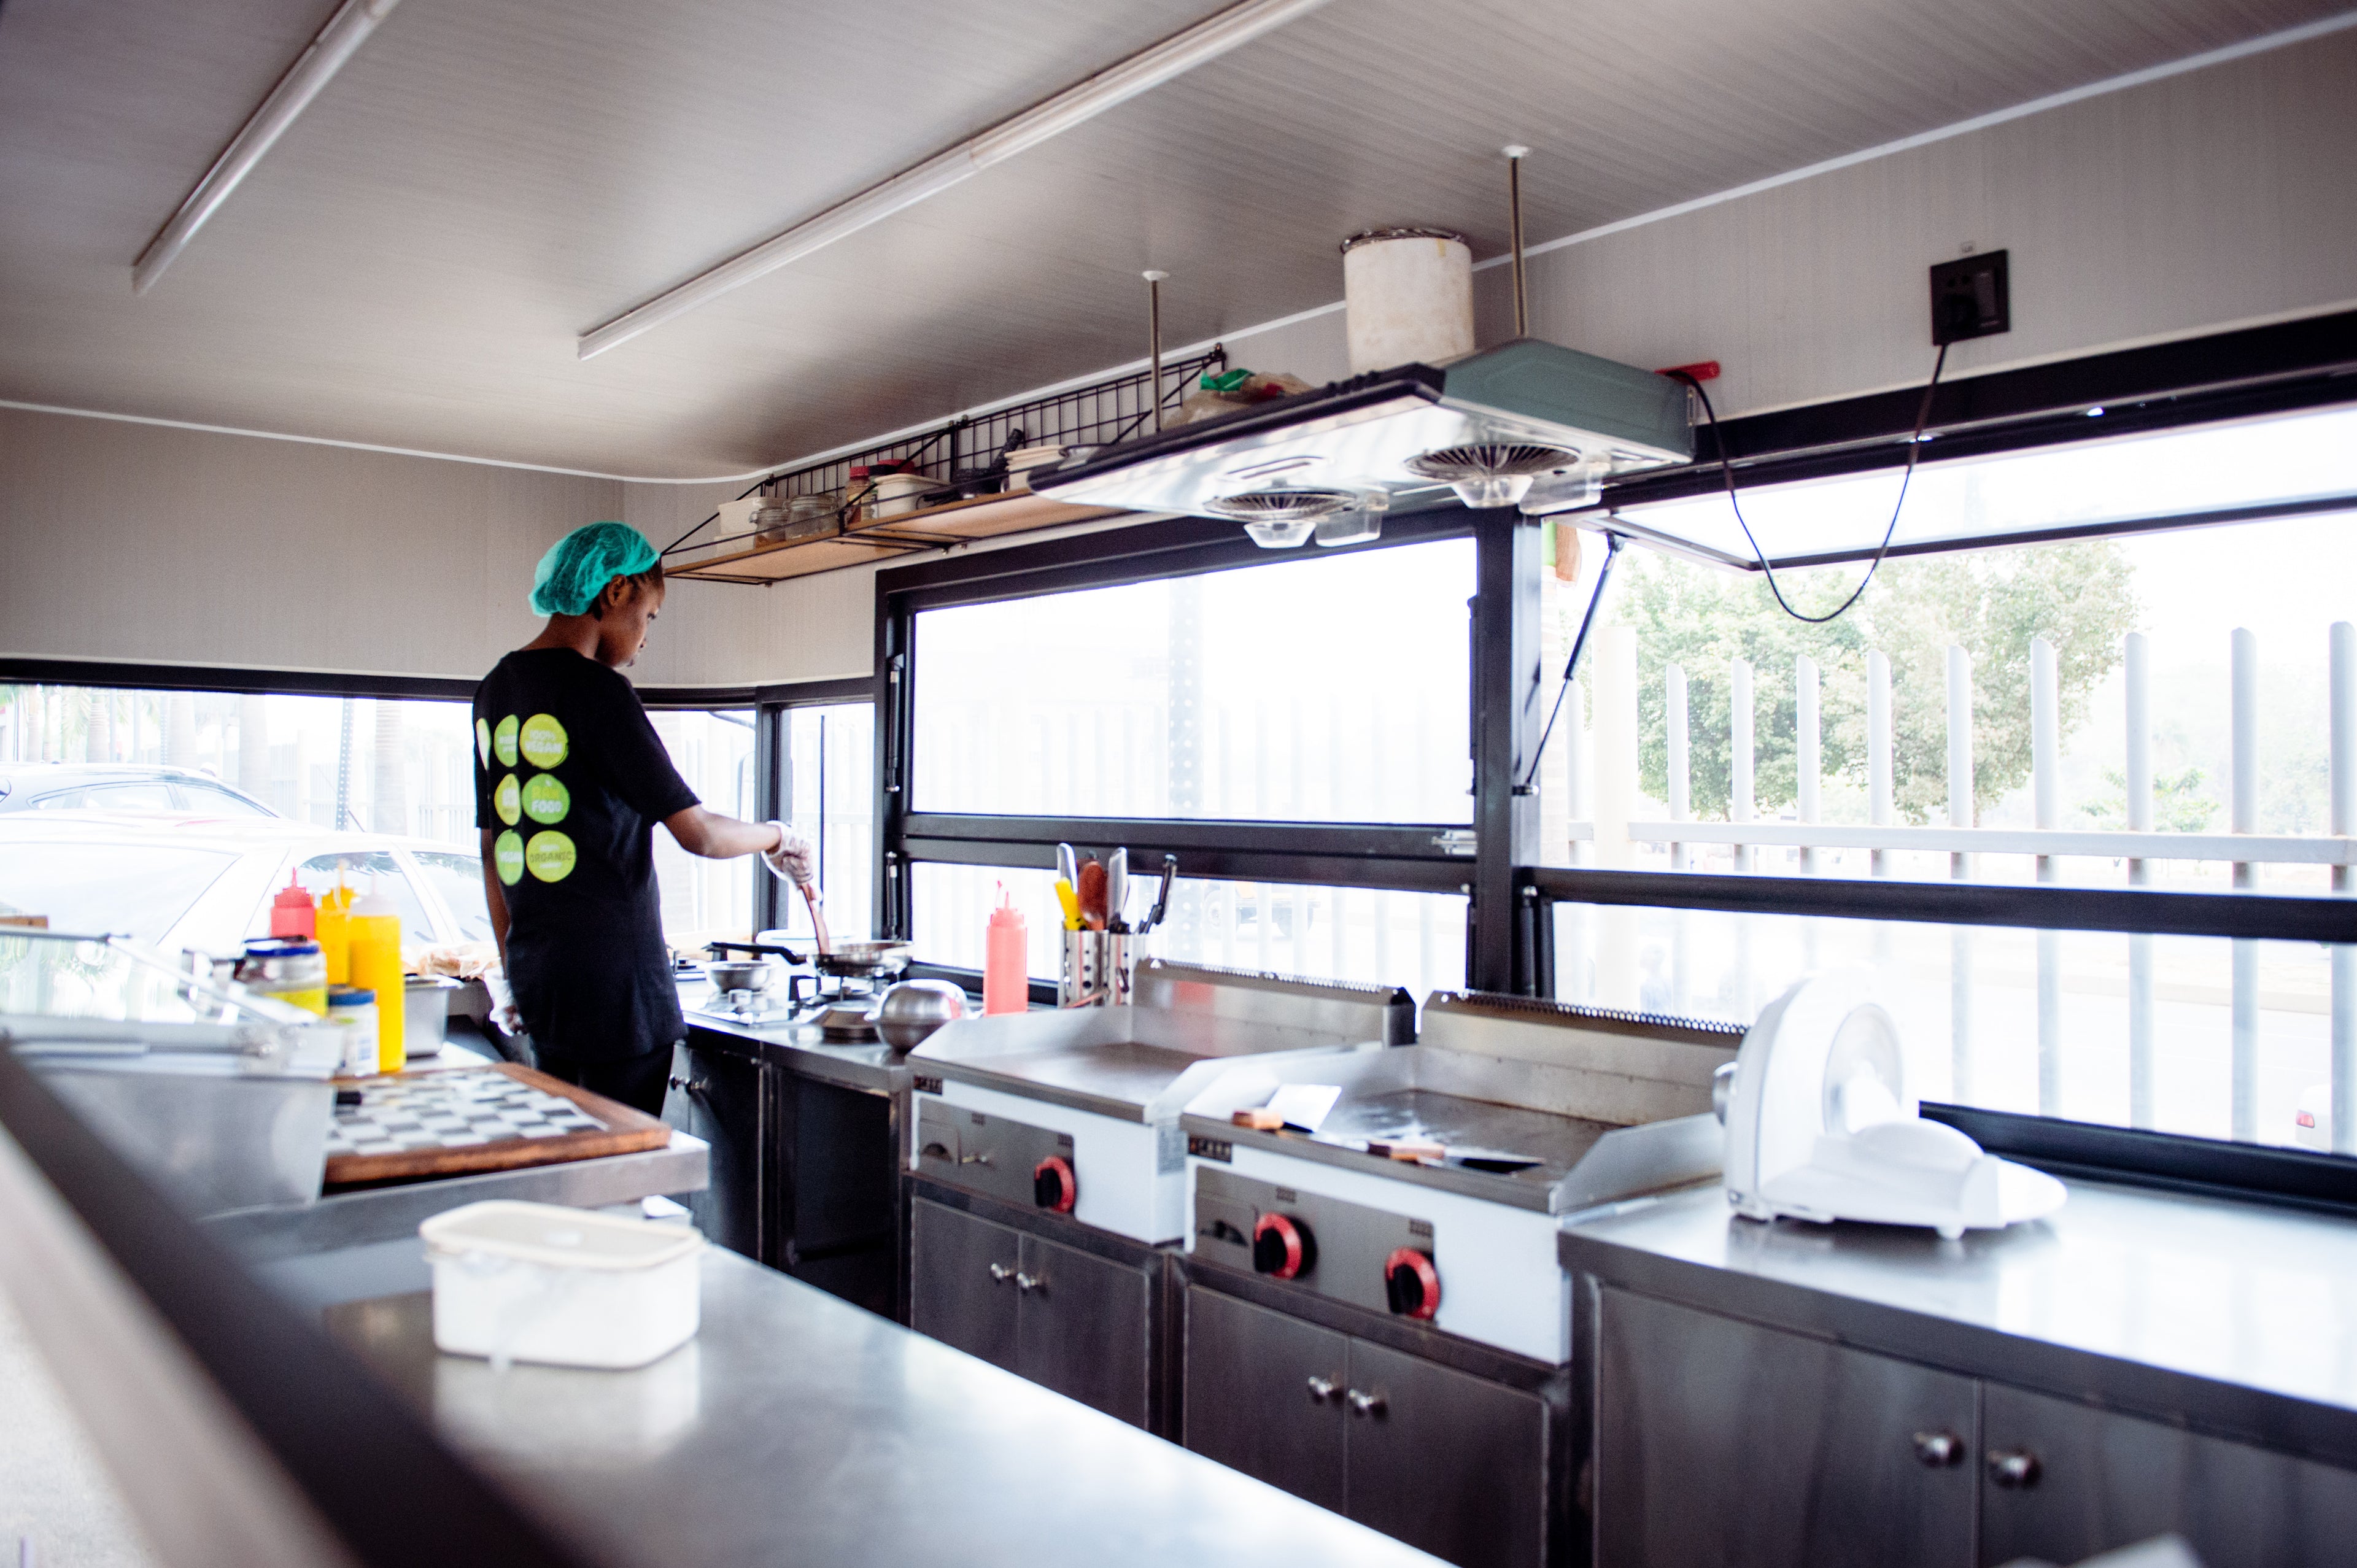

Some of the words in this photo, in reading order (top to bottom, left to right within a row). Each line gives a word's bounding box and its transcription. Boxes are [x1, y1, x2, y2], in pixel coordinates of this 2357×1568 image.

[525, 741, 562, 754] VEGAN
[532, 800, 562, 813] FOOD
[529, 851, 573, 863] ORGANIC
